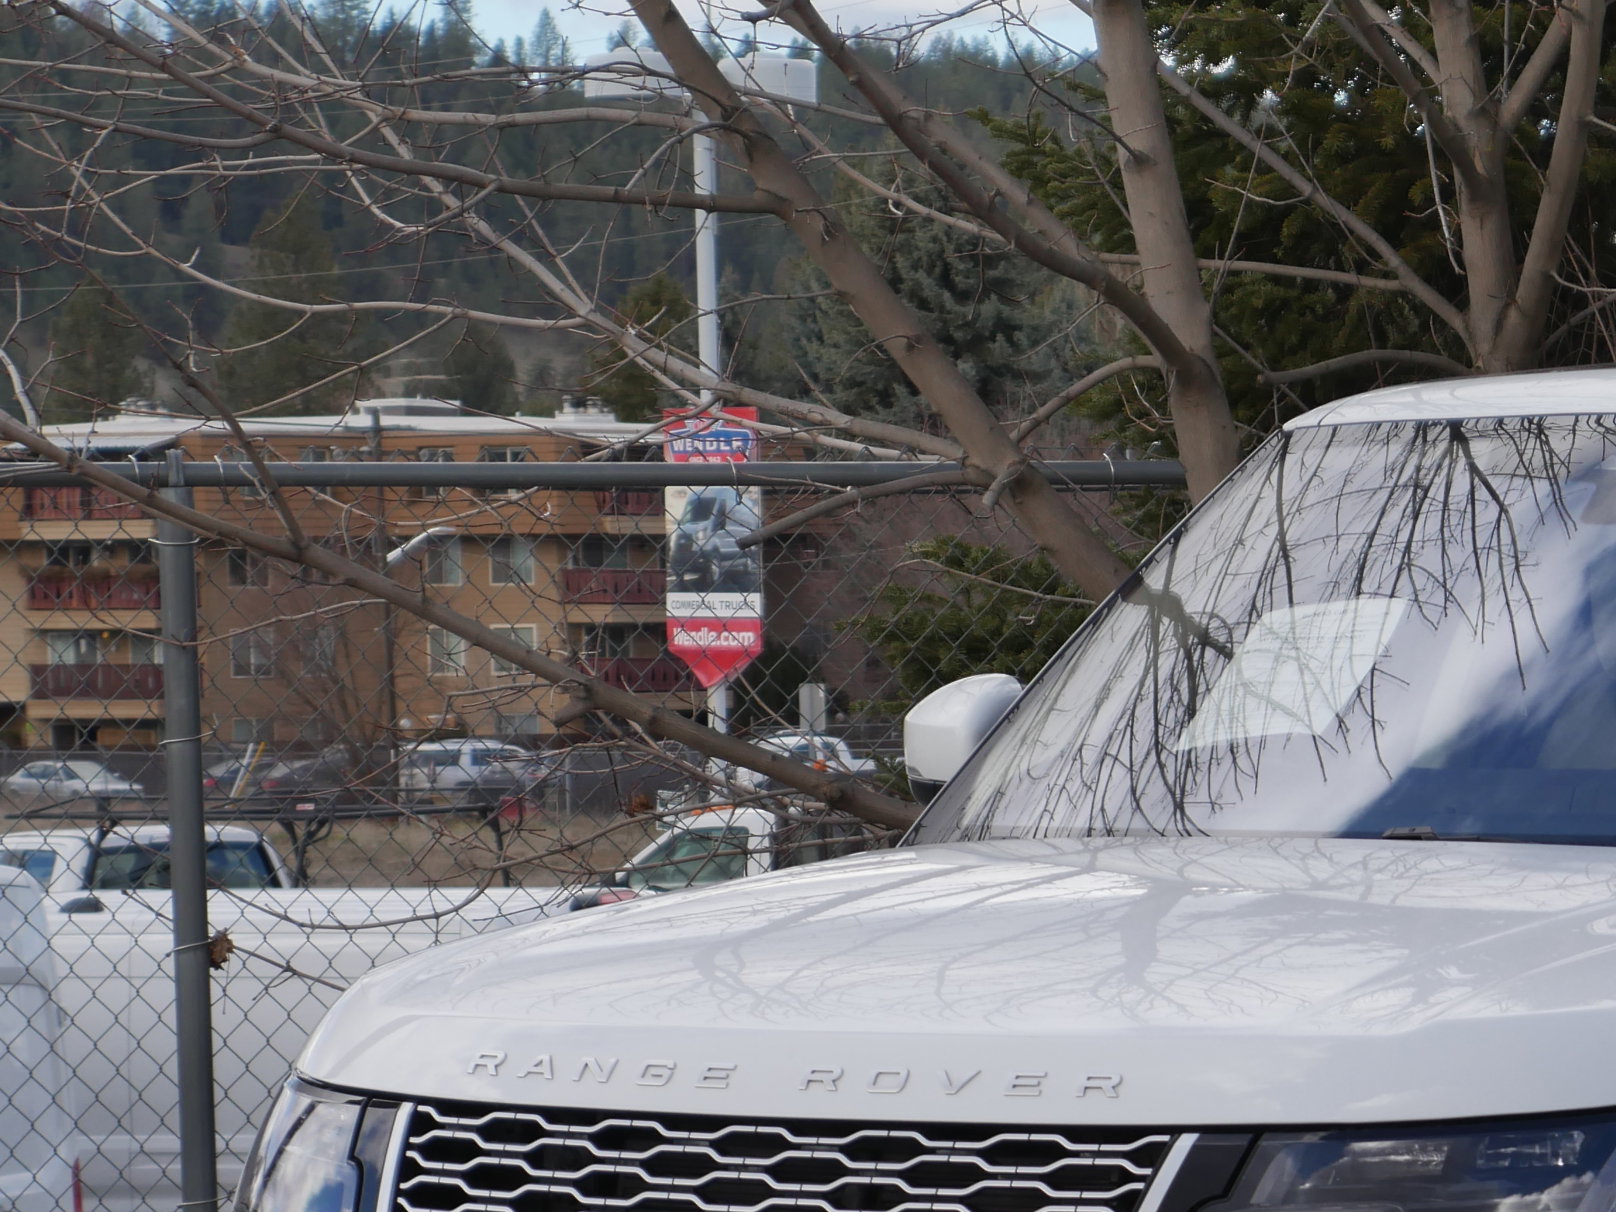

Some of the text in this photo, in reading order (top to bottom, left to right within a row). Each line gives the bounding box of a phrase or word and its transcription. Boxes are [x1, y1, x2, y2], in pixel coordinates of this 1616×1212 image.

[672, 437, 743, 452] WENDLE
[670, 600, 717, 610] COMMERAL
[673, 627, 755, 646] Wendle.com
[466, 1050, 1125, 1099] RANGE ROVER
